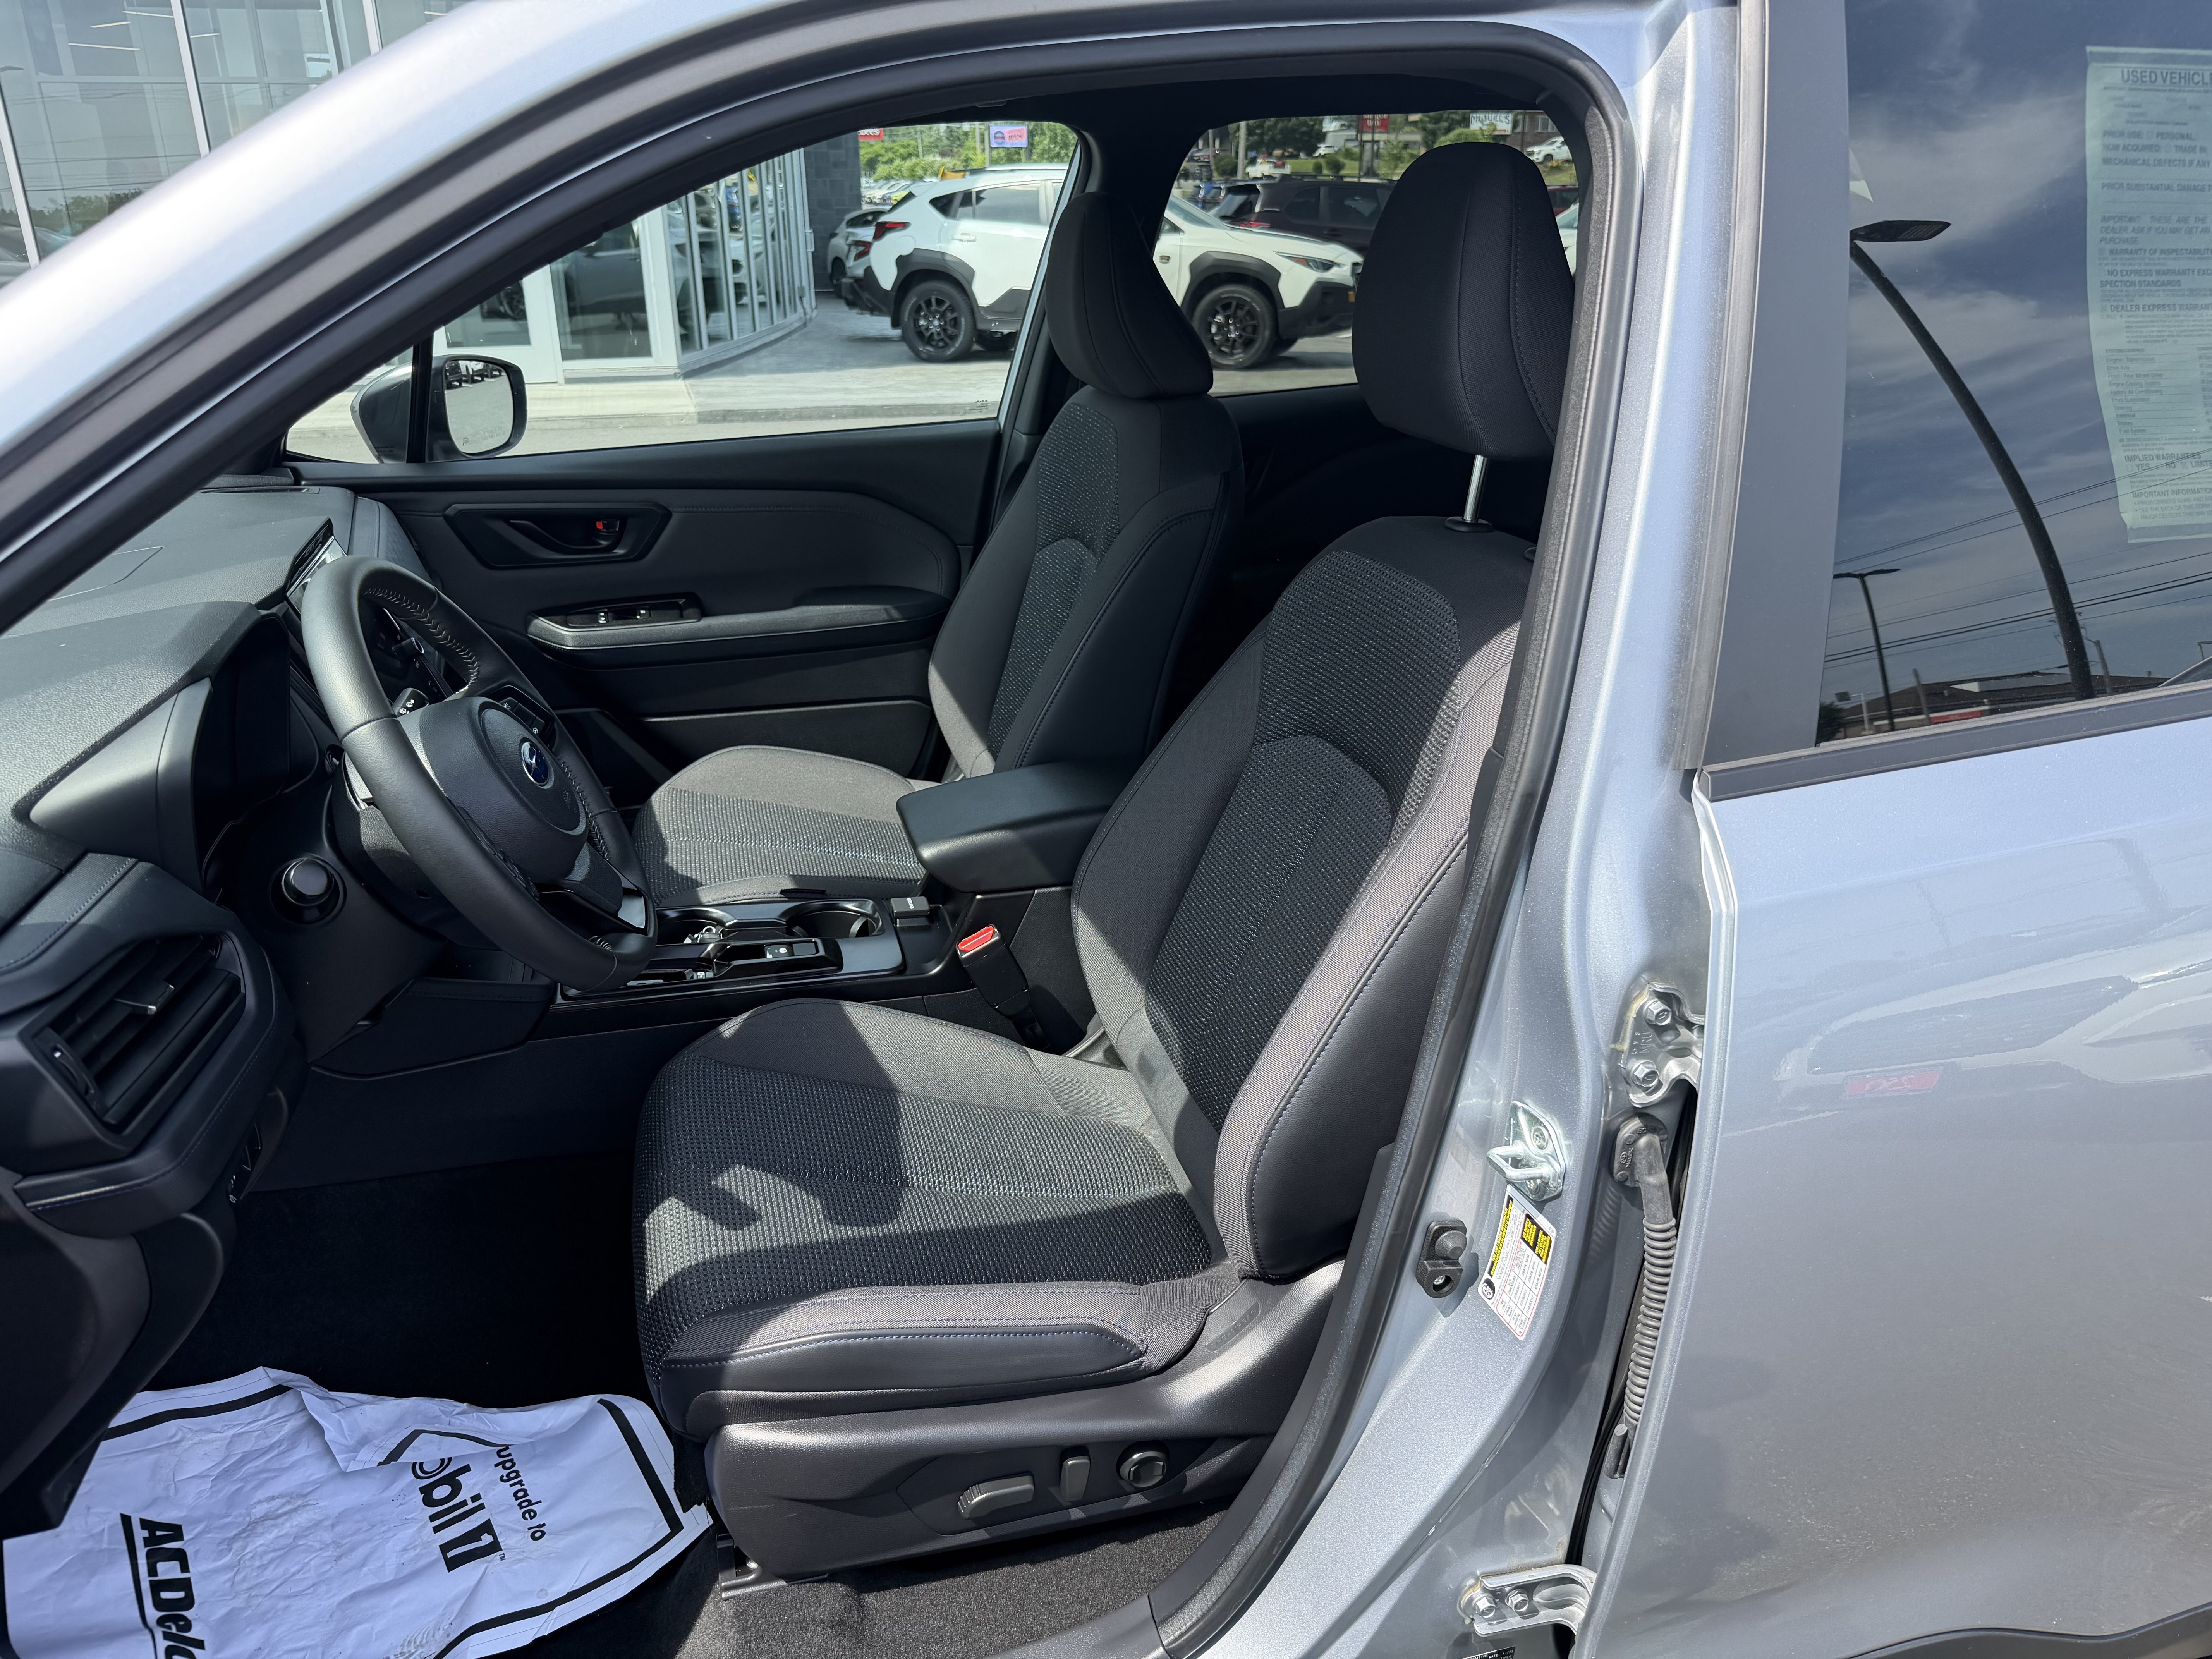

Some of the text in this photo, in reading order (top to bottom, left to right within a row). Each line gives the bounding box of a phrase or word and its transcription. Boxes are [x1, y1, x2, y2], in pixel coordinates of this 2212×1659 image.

[2121, 69, 2158, 84] USED
[2110, 304, 2140, 312] DEALER
[2142, 304, 2177, 312] EXPRESS
[2124, 454, 2154, 462] IMPLIED
[2133, 490, 2169, 498] IMPORTANT
[411, 1457, 486, 1534] obil
[494, 1446, 546, 1541] upgrade to
